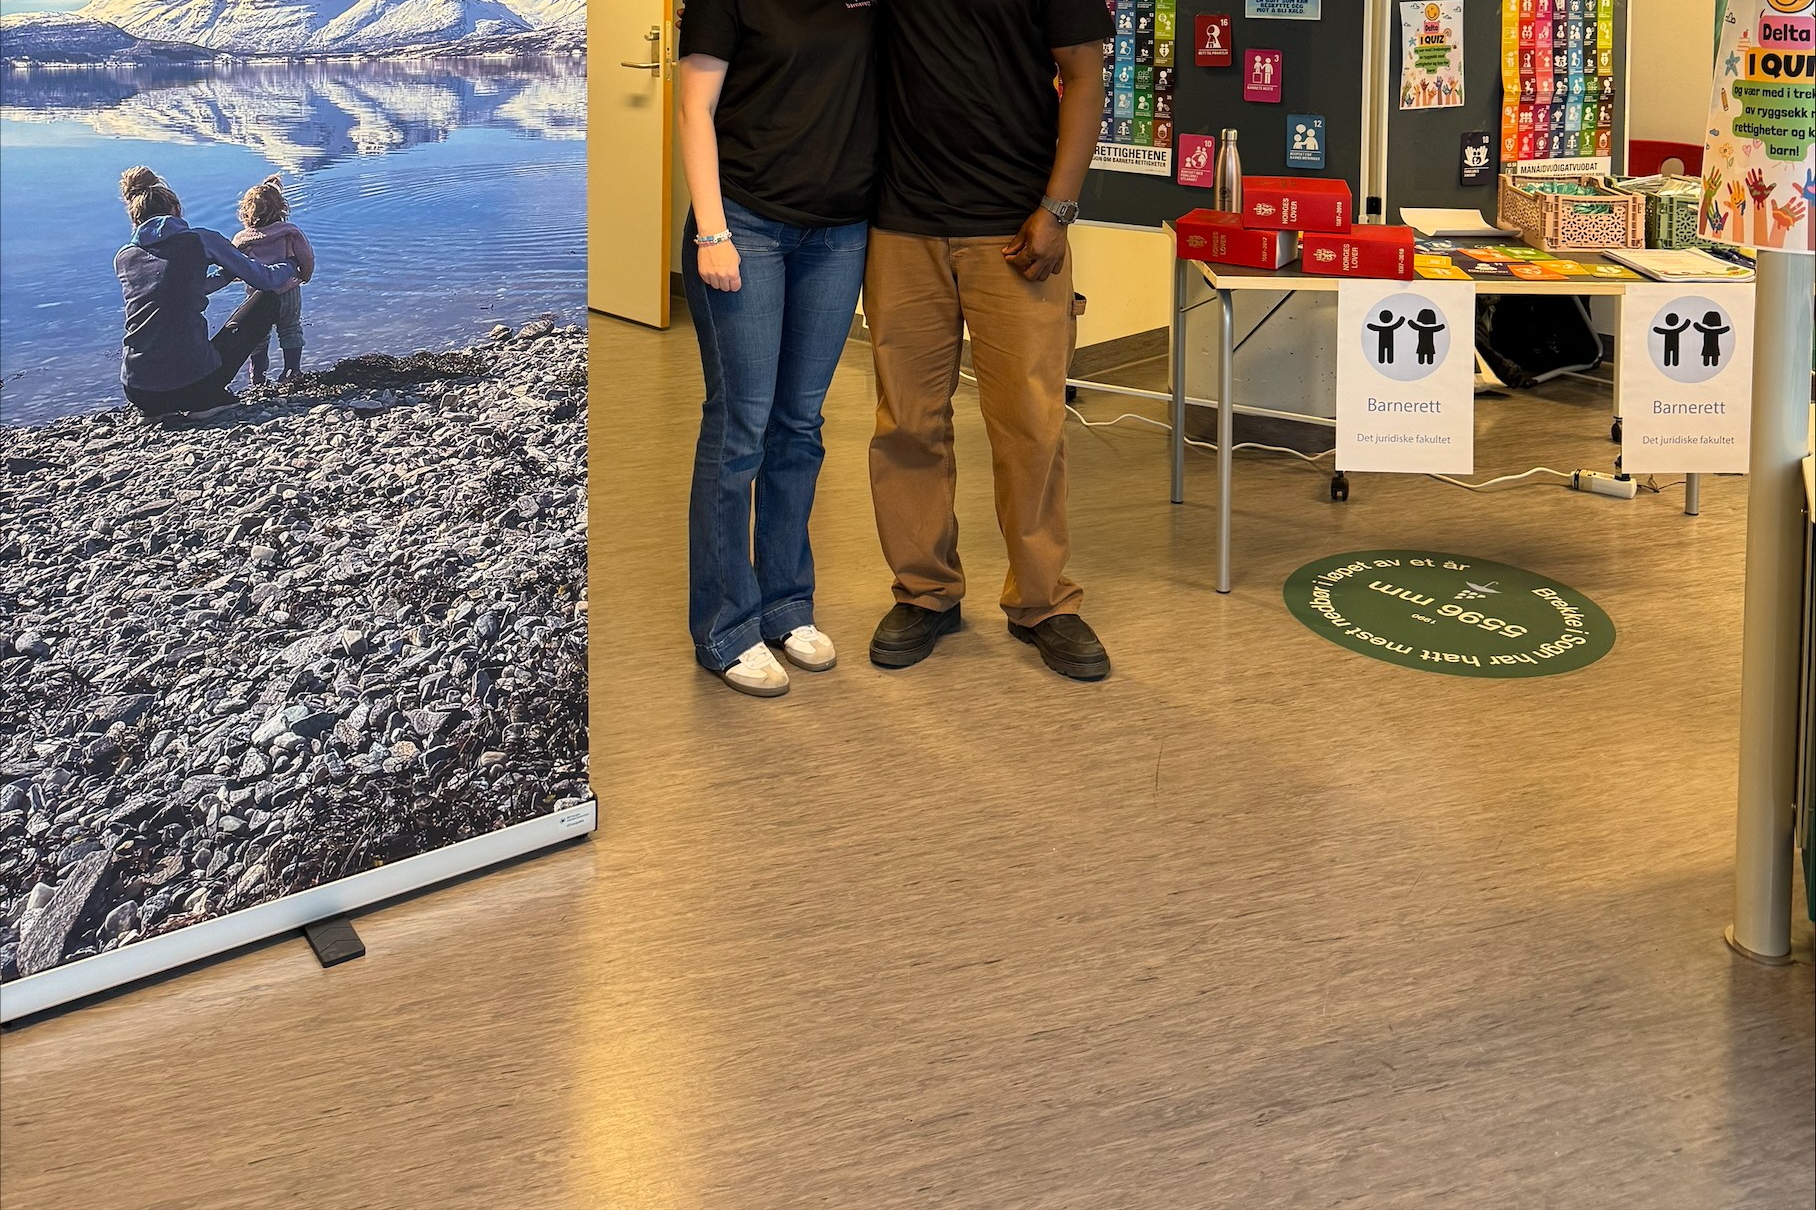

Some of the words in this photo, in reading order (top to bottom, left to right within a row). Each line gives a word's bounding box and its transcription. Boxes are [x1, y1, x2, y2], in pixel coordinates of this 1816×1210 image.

[1220, 18, 1228, 26] 16
[1424, 34, 1445, 44] QUIZ
[1763, 23, 1810, 42] Delta
[1274, 54, 1280, 62] 3
[1750, 54, 1756, 76] I
[1761, 53, 1815, 78] QUI
[1734, 86, 1742, 96] og
[1744, 87, 1760, 96] vær
[1762, 88, 1784, 98] med
[1787, 88, 1790, 98] i
[1746, 106, 1756, 115] av
[1758, 107, 1808, 119] ryggsekk
[1734, 122, 1788, 137] rettigheter
[1094, 146, 1167, 162] RETTIGHETENE
[1770, 144, 1799, 156] barn!
[1368, 398, 1442, 413] Barnerett
[1653, 400, 1726, 414] Barnerett
[1357, 433, 1374, 442] Det
[1375, 434, 1414, 444] juridiske
[1416, 434, 1451, 444] fakultet
[1642, 436, 1658, 444] Det
[1660, 436, 1698, 446] juridiske
[1700, 436, 1735, 444] fakultet
[1373, 559, 1400, 568] av
[1409, 558, 1436, 568] et
[1442, 559, 1471, 571] år
[1318, 560, 1372, 582] løpet
[1368, 580, 1436, 606] mm
[1309, 586, 1352, 627] nedbør
[1531, 588, 1585, 628] Brekke
[1411, 613, 1437, 625] 1990
[1436, 604, 1528, 638] 5596
[1344, 627, 1414, 655] mest
[1532, 634, 1586, 659] Sogn
[1419, 649, 1481, 667] hatt
[1490, 652, 1539, 665] har
